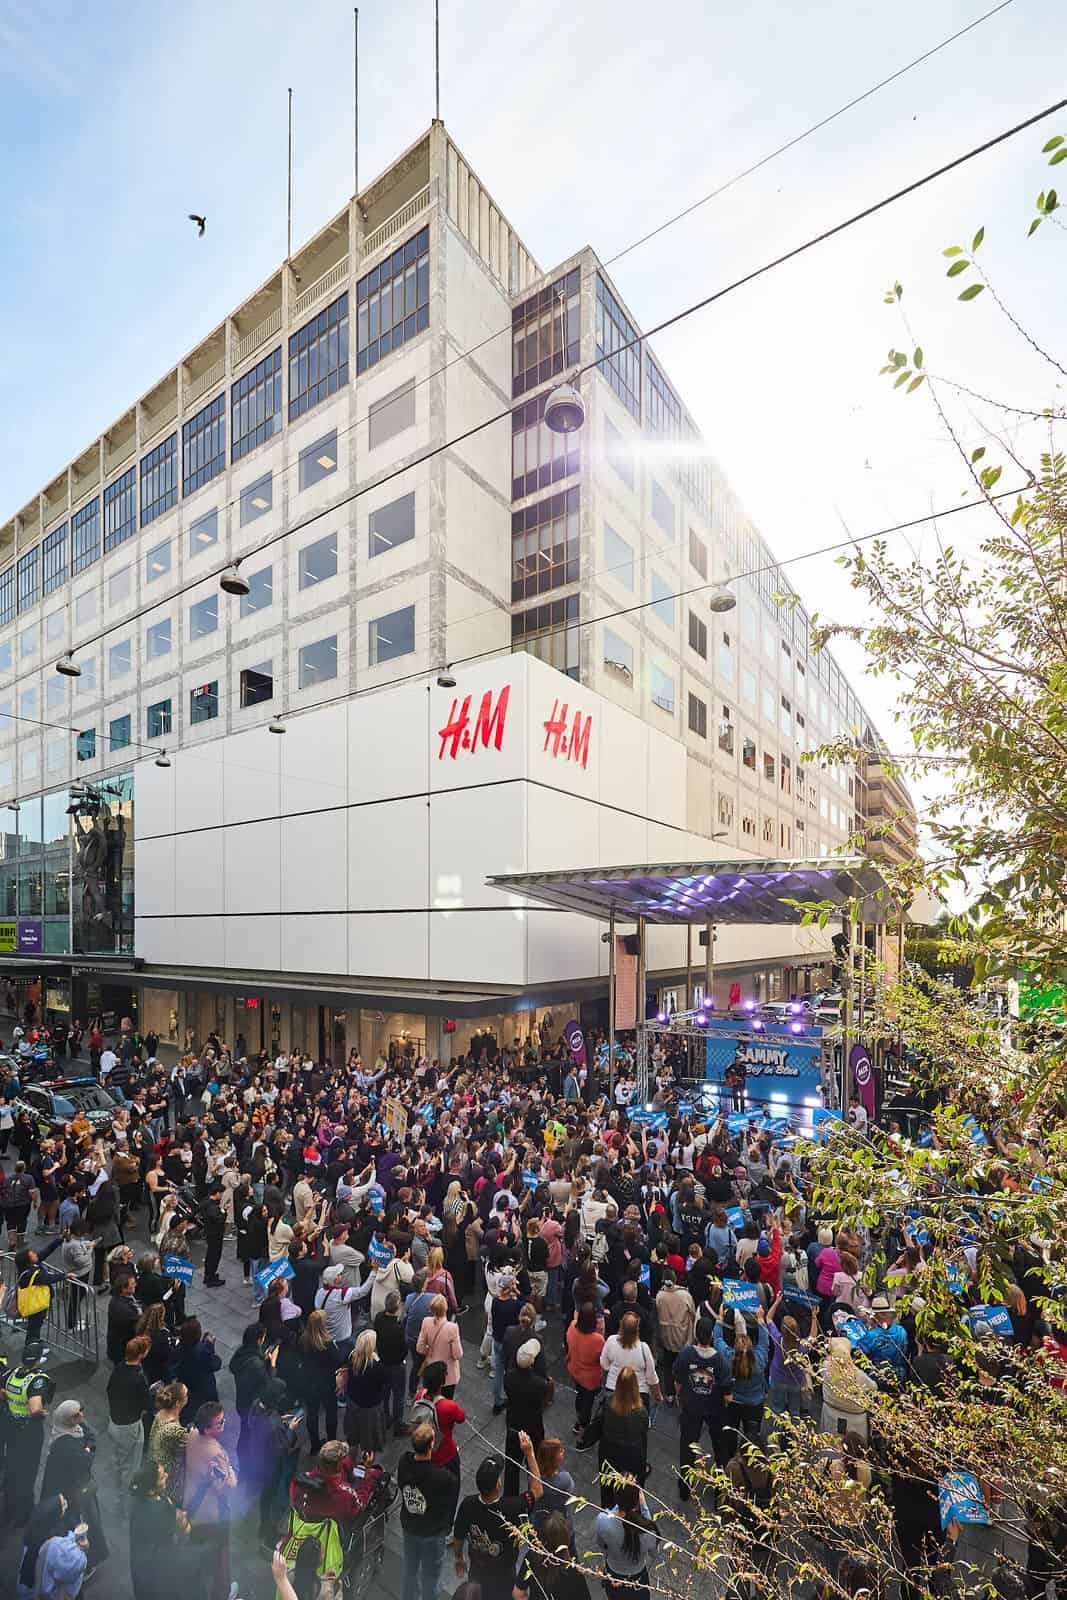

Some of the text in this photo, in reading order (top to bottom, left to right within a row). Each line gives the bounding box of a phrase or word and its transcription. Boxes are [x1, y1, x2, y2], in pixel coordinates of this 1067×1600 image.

[438, 684, 511, 760] H&M
[543, 698, 592, 770] H&M
[736, 1045, 788, 1066] SAMMY
